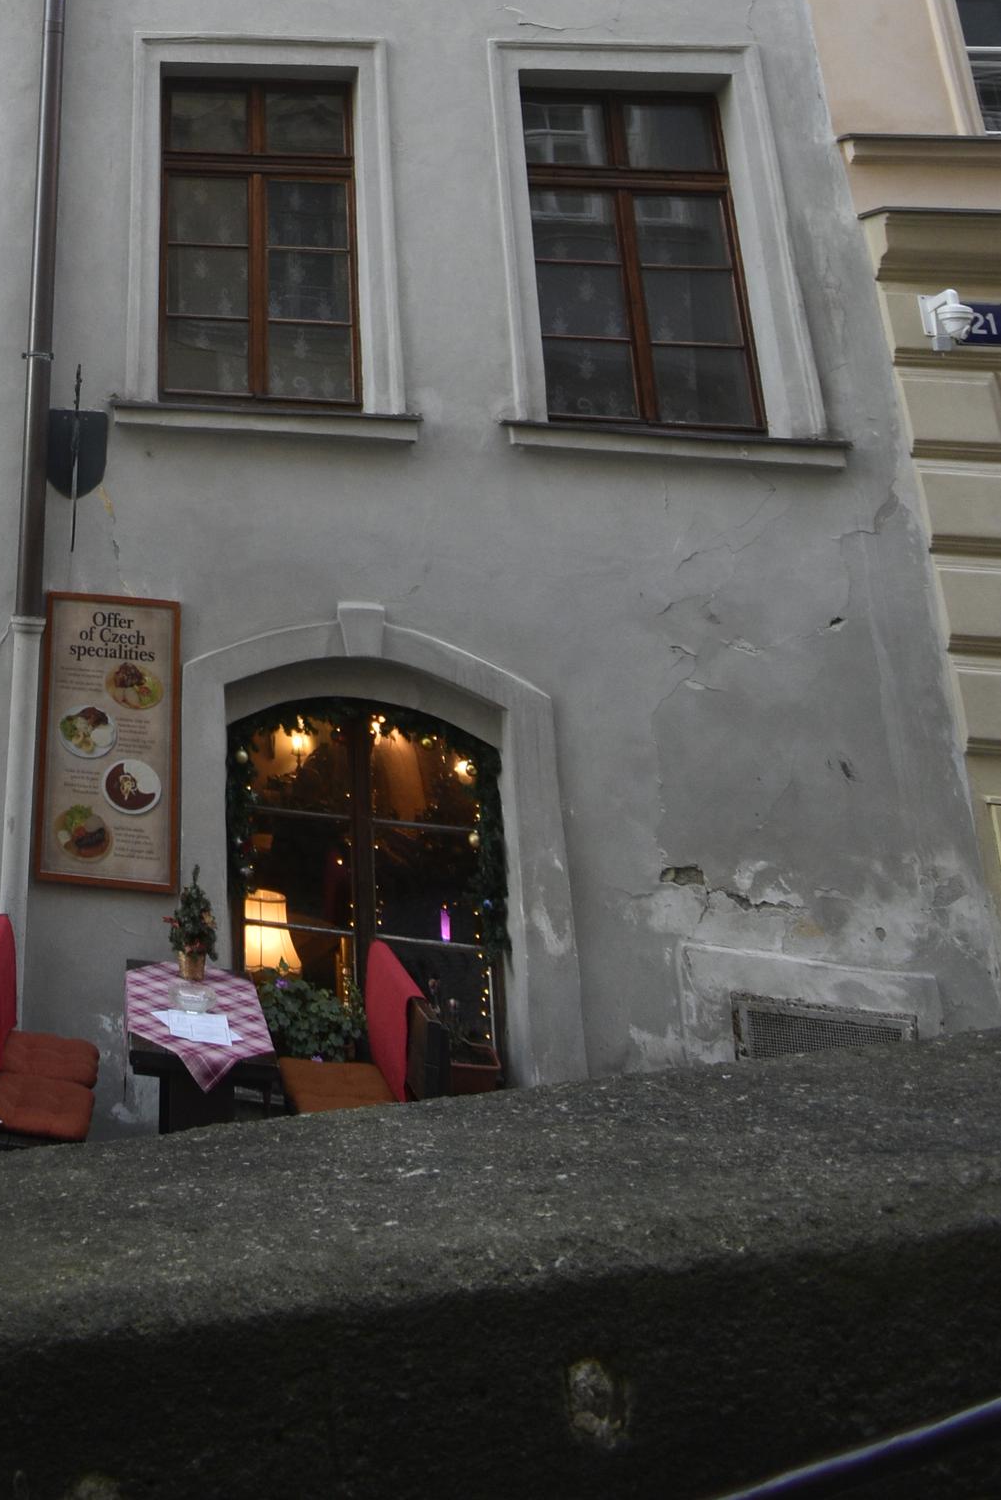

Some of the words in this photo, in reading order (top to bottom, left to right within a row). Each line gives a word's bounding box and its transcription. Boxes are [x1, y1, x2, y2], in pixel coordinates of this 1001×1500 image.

[972, 312, 998, 335] 21
[92, 611, 134, 629] Offer
[79, 626, 96, 640] of
[99, 627, 146, 646] Czech
[69, 643, 156, 661] specialities
